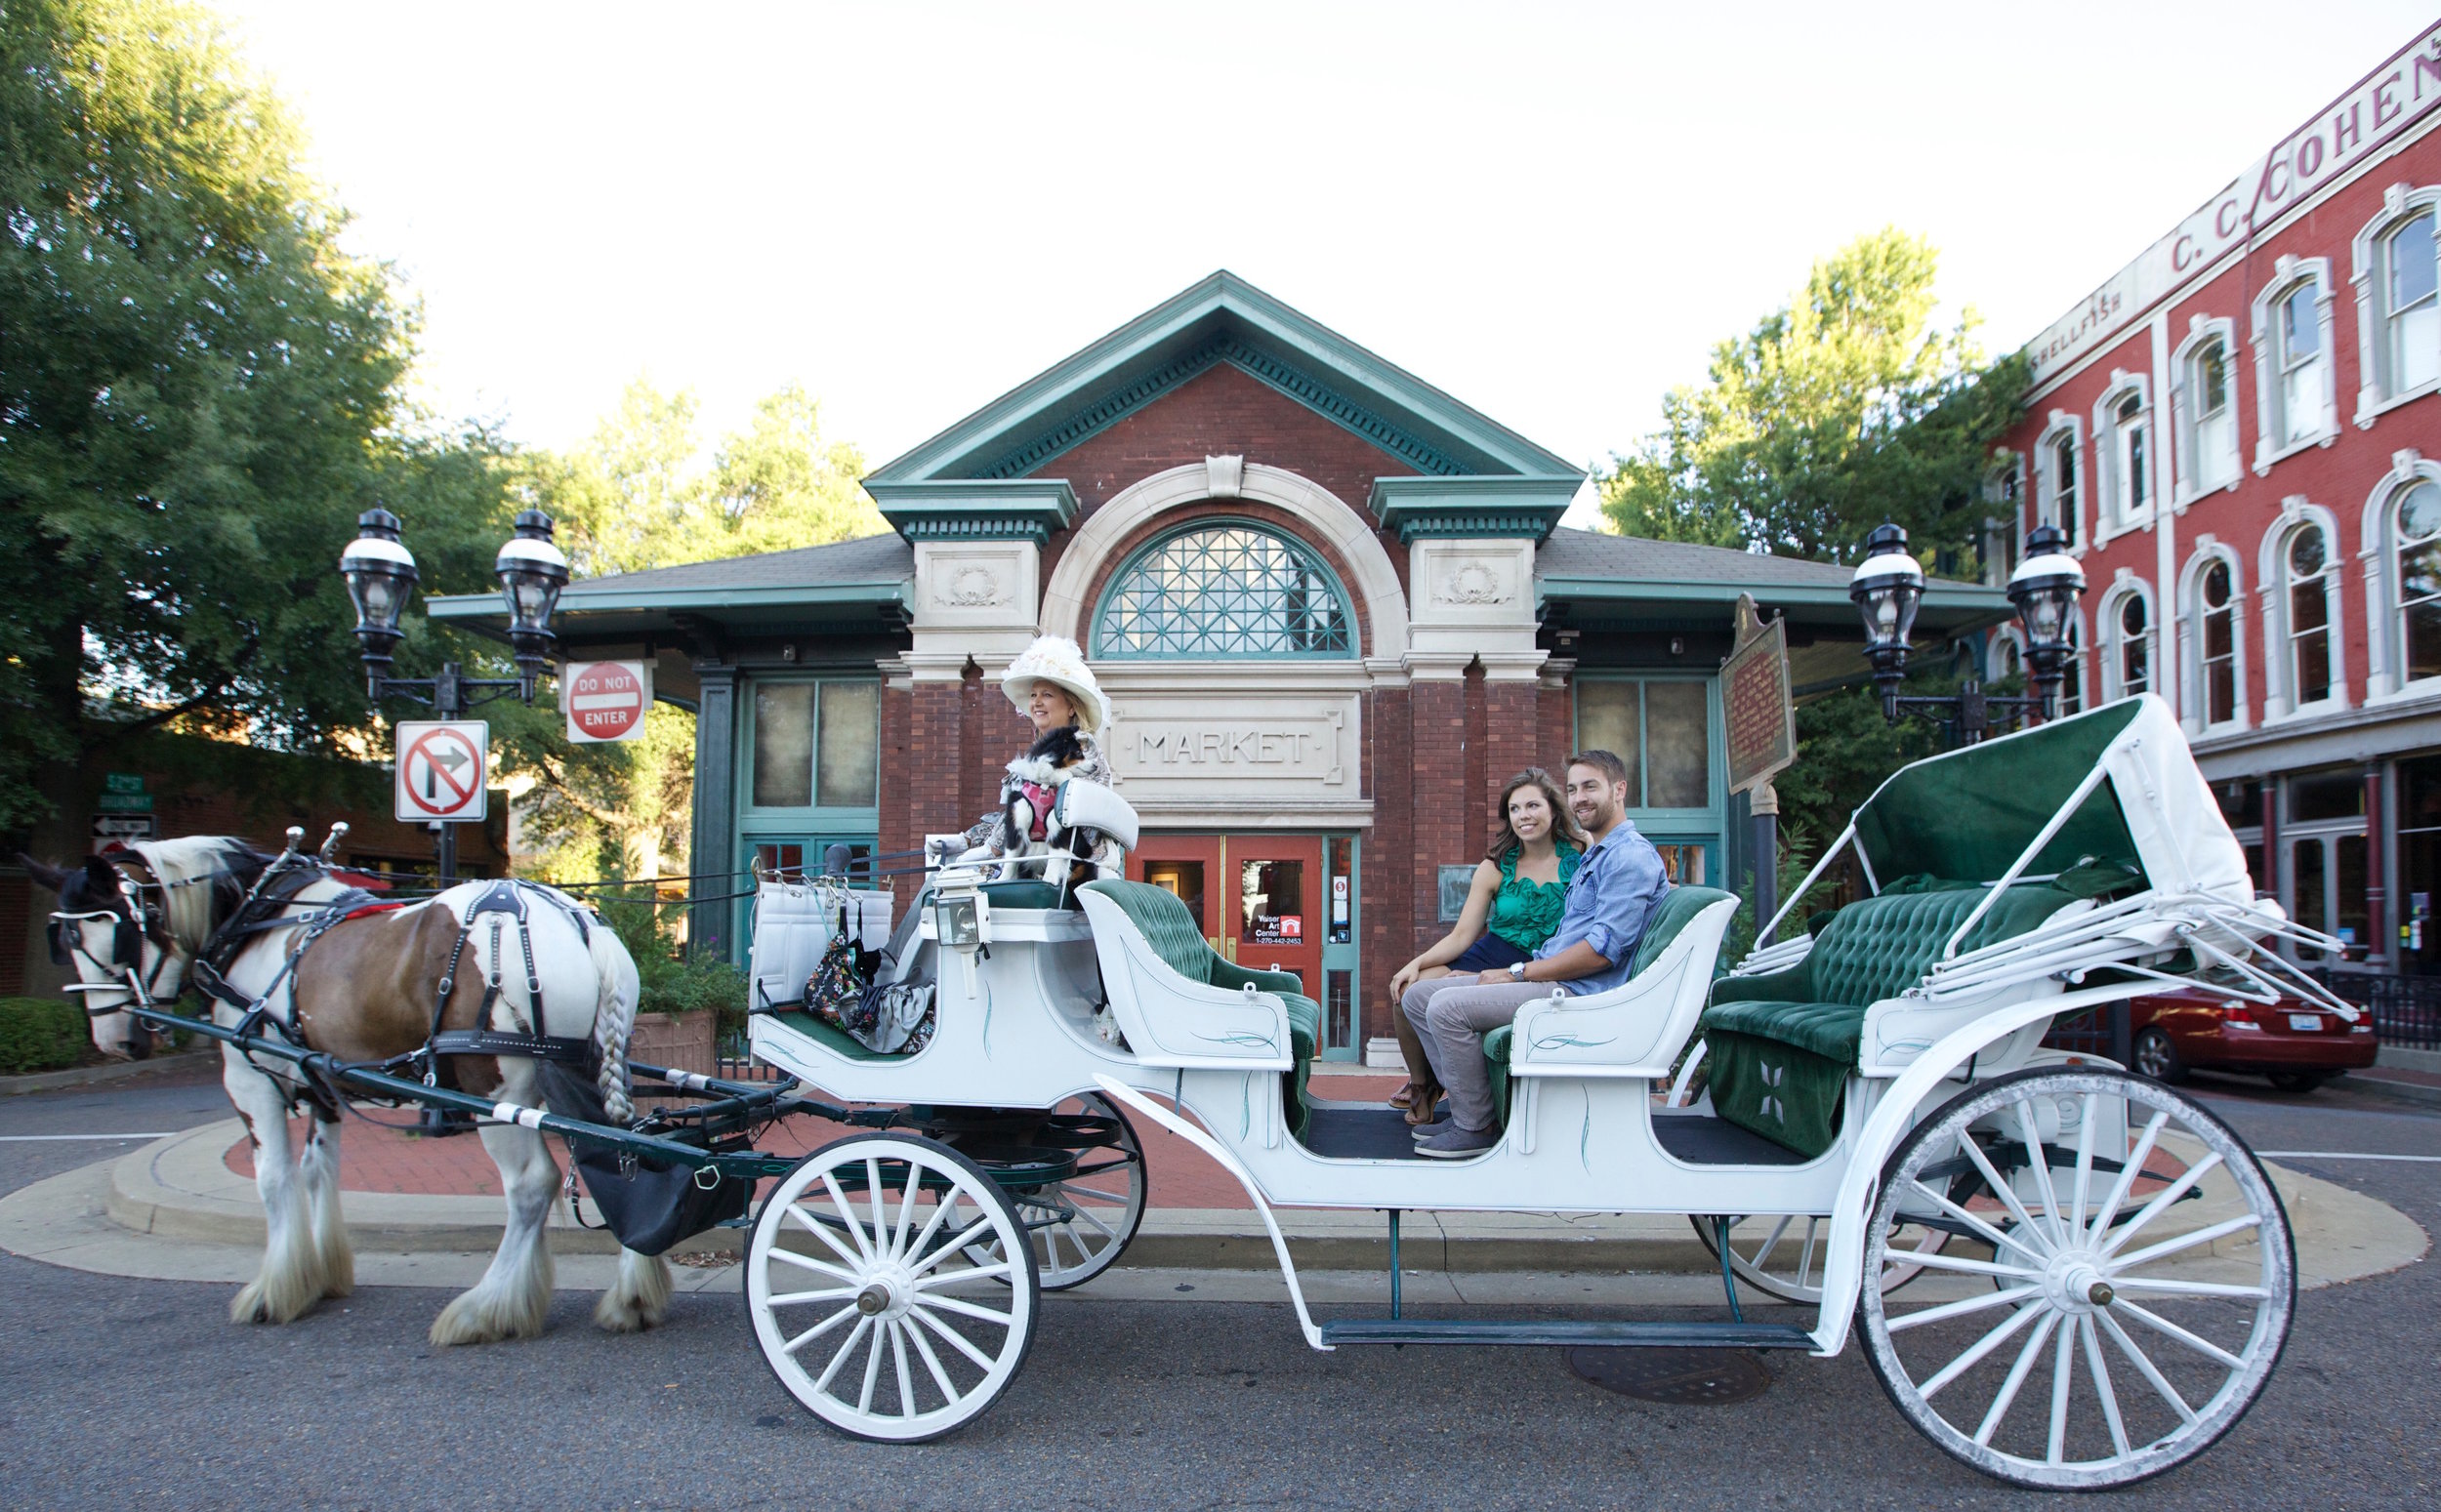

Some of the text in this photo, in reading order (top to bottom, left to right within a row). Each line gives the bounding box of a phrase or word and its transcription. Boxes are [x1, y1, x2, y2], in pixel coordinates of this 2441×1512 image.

[2172, 234, 2203, 272] C.
[2030, 291, 2122, 371] SHELLFISH
[579, 675, 631, 691] DO NOT
[585, 711, 627, 726] ENTER
[1138, 731, 1311, 763] MARKET
